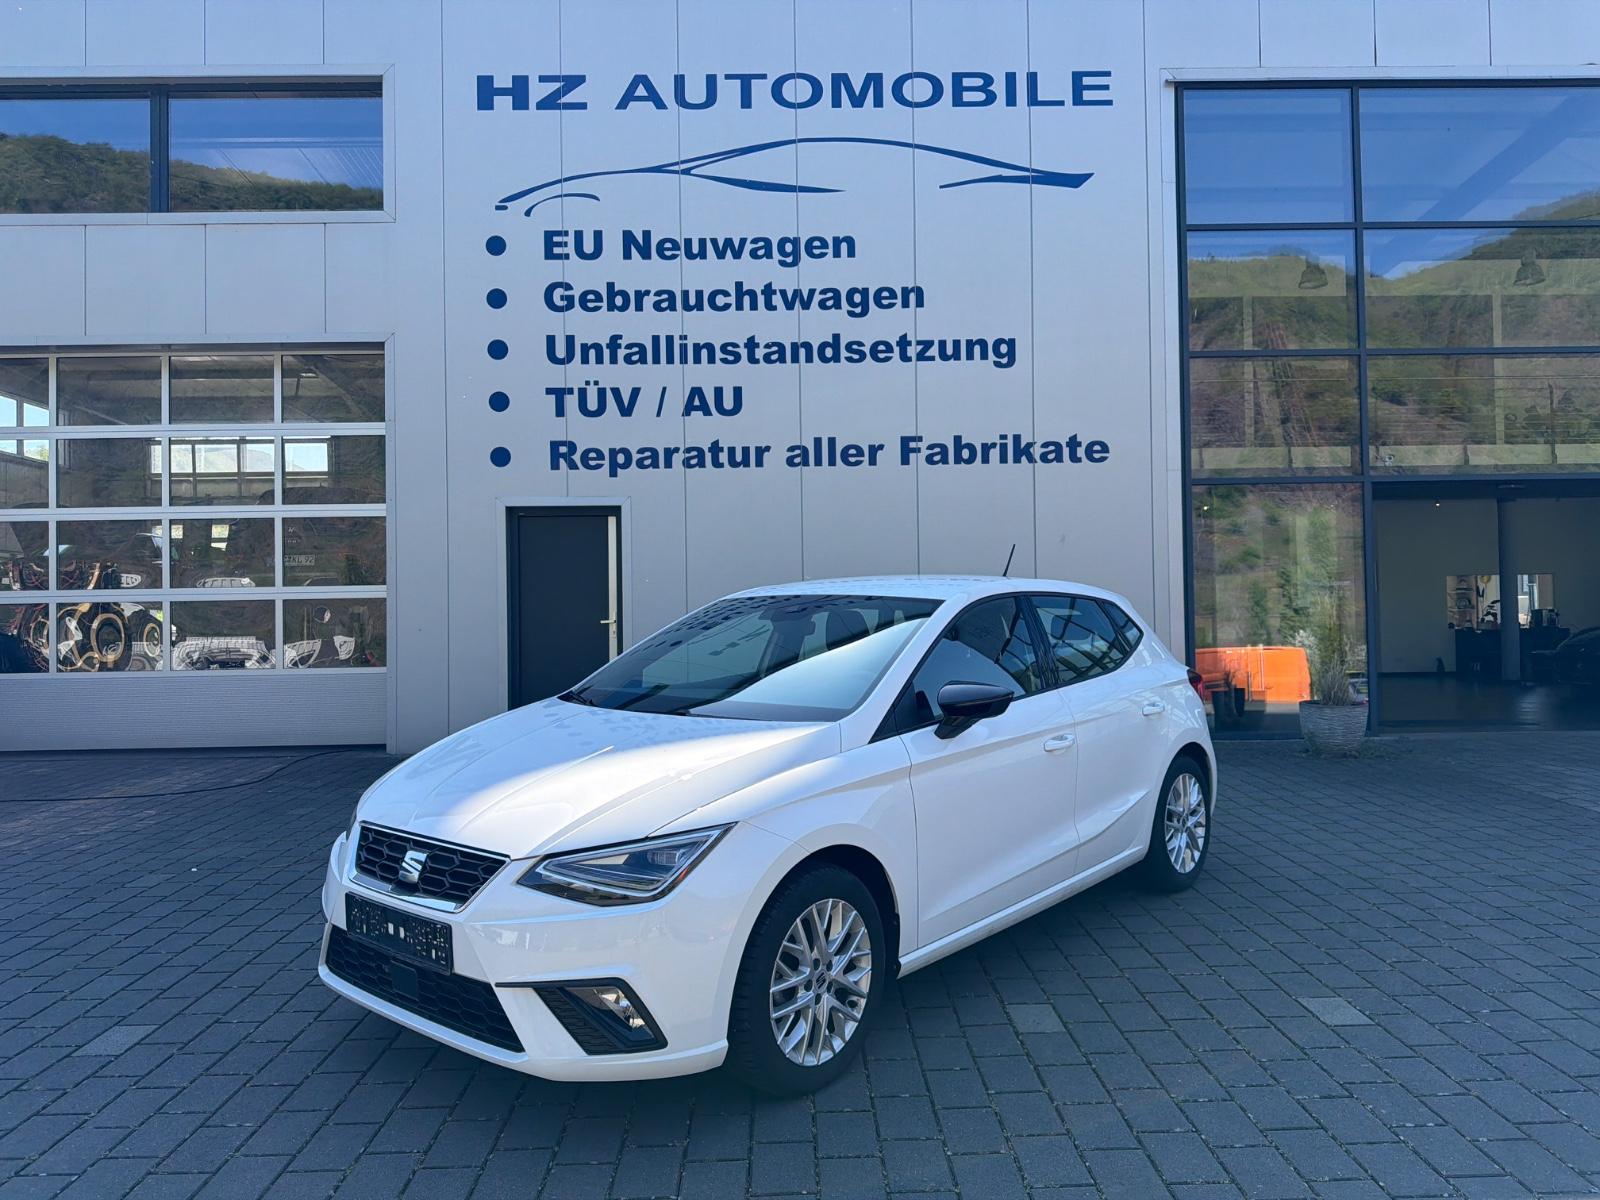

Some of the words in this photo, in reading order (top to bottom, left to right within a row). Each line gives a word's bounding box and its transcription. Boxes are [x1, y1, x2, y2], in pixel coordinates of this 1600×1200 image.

[476, 74, 588, 111] HZ
[614, 71, 1114, 110] AUTOMOBILE
[543, 229, 604, 261] EU
[622, 230, 857, 267] Neuwagen
[543, 280, 926, 318] Gebrauchtwagen
[545, 332, 1016, 369] Unfallinstandsetzung
[545, 380, 642, 418] TÜV
[655, 386, 668, 418] /
[681, 385, 743, 417] AU
[549, 438, 772, 478] Reparatur
[785, 436, 885, 468] aller
[900, 433, 1110, 466] Fabrikate
